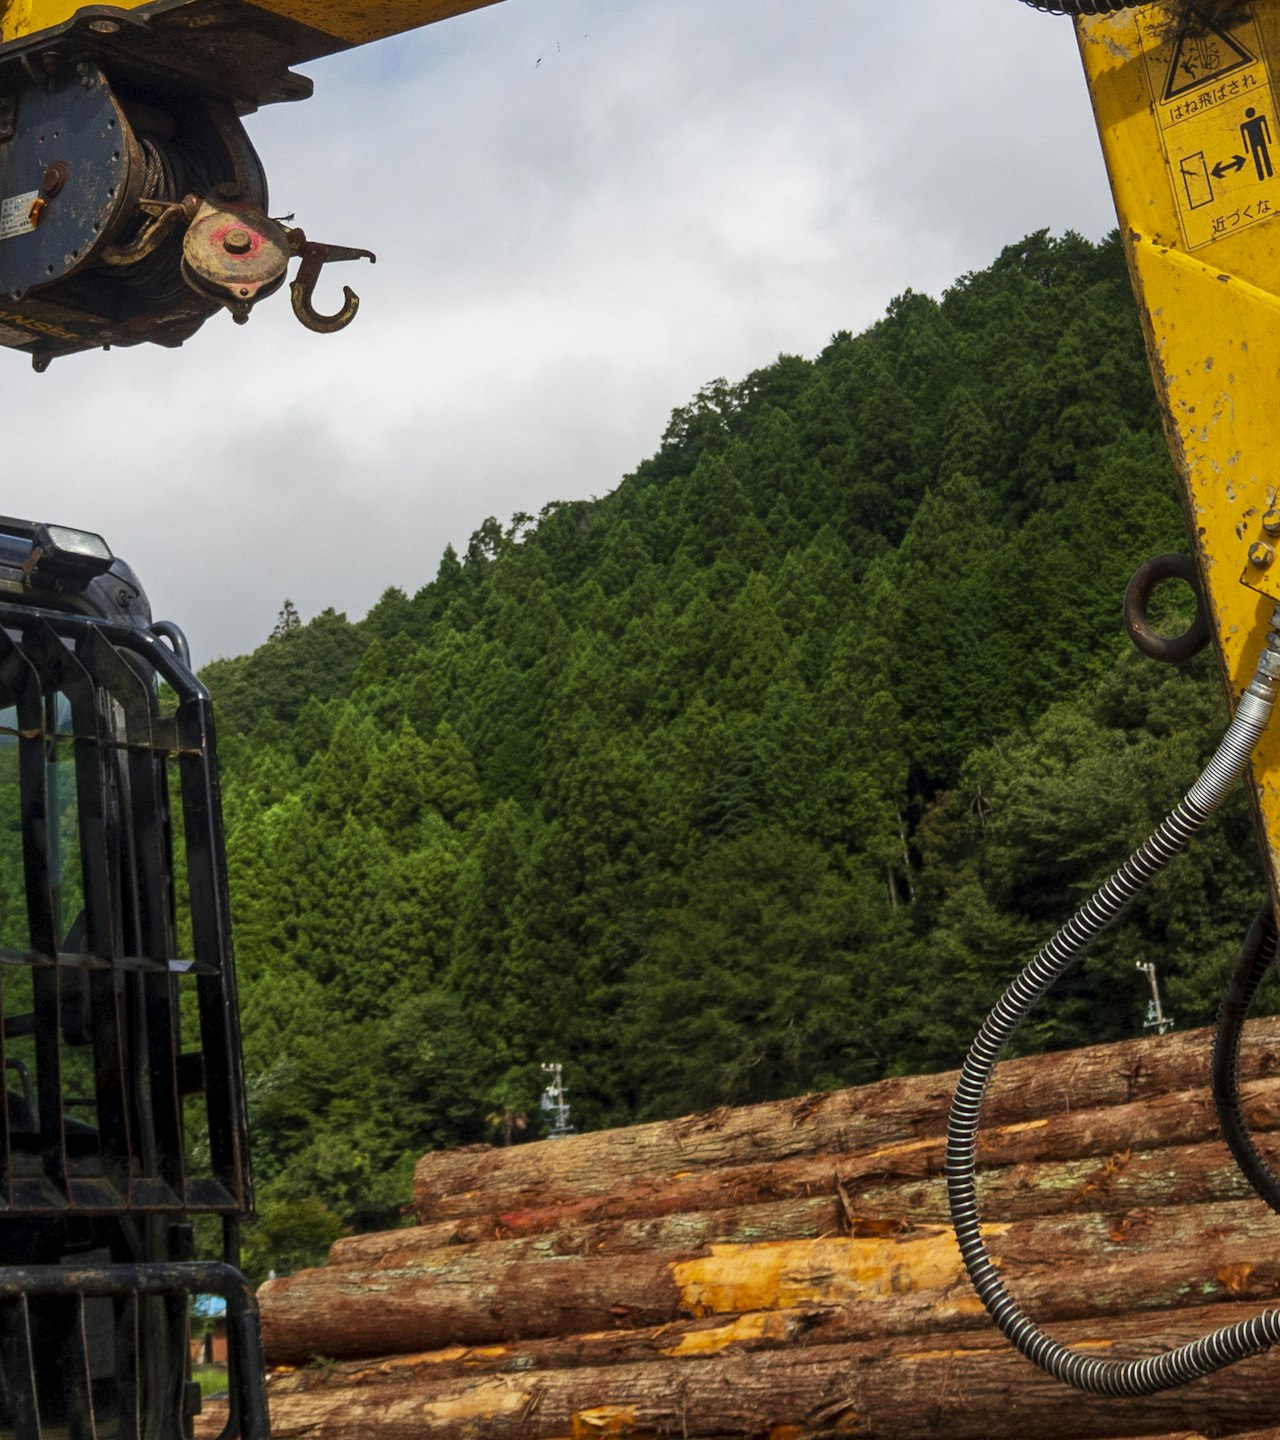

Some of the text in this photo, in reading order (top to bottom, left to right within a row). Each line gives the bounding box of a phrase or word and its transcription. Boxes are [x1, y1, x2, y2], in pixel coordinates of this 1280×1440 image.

[1171, 74, 1257, 121] はね飛ばされ
[1212, 199, 1271, 234] 近づくな
